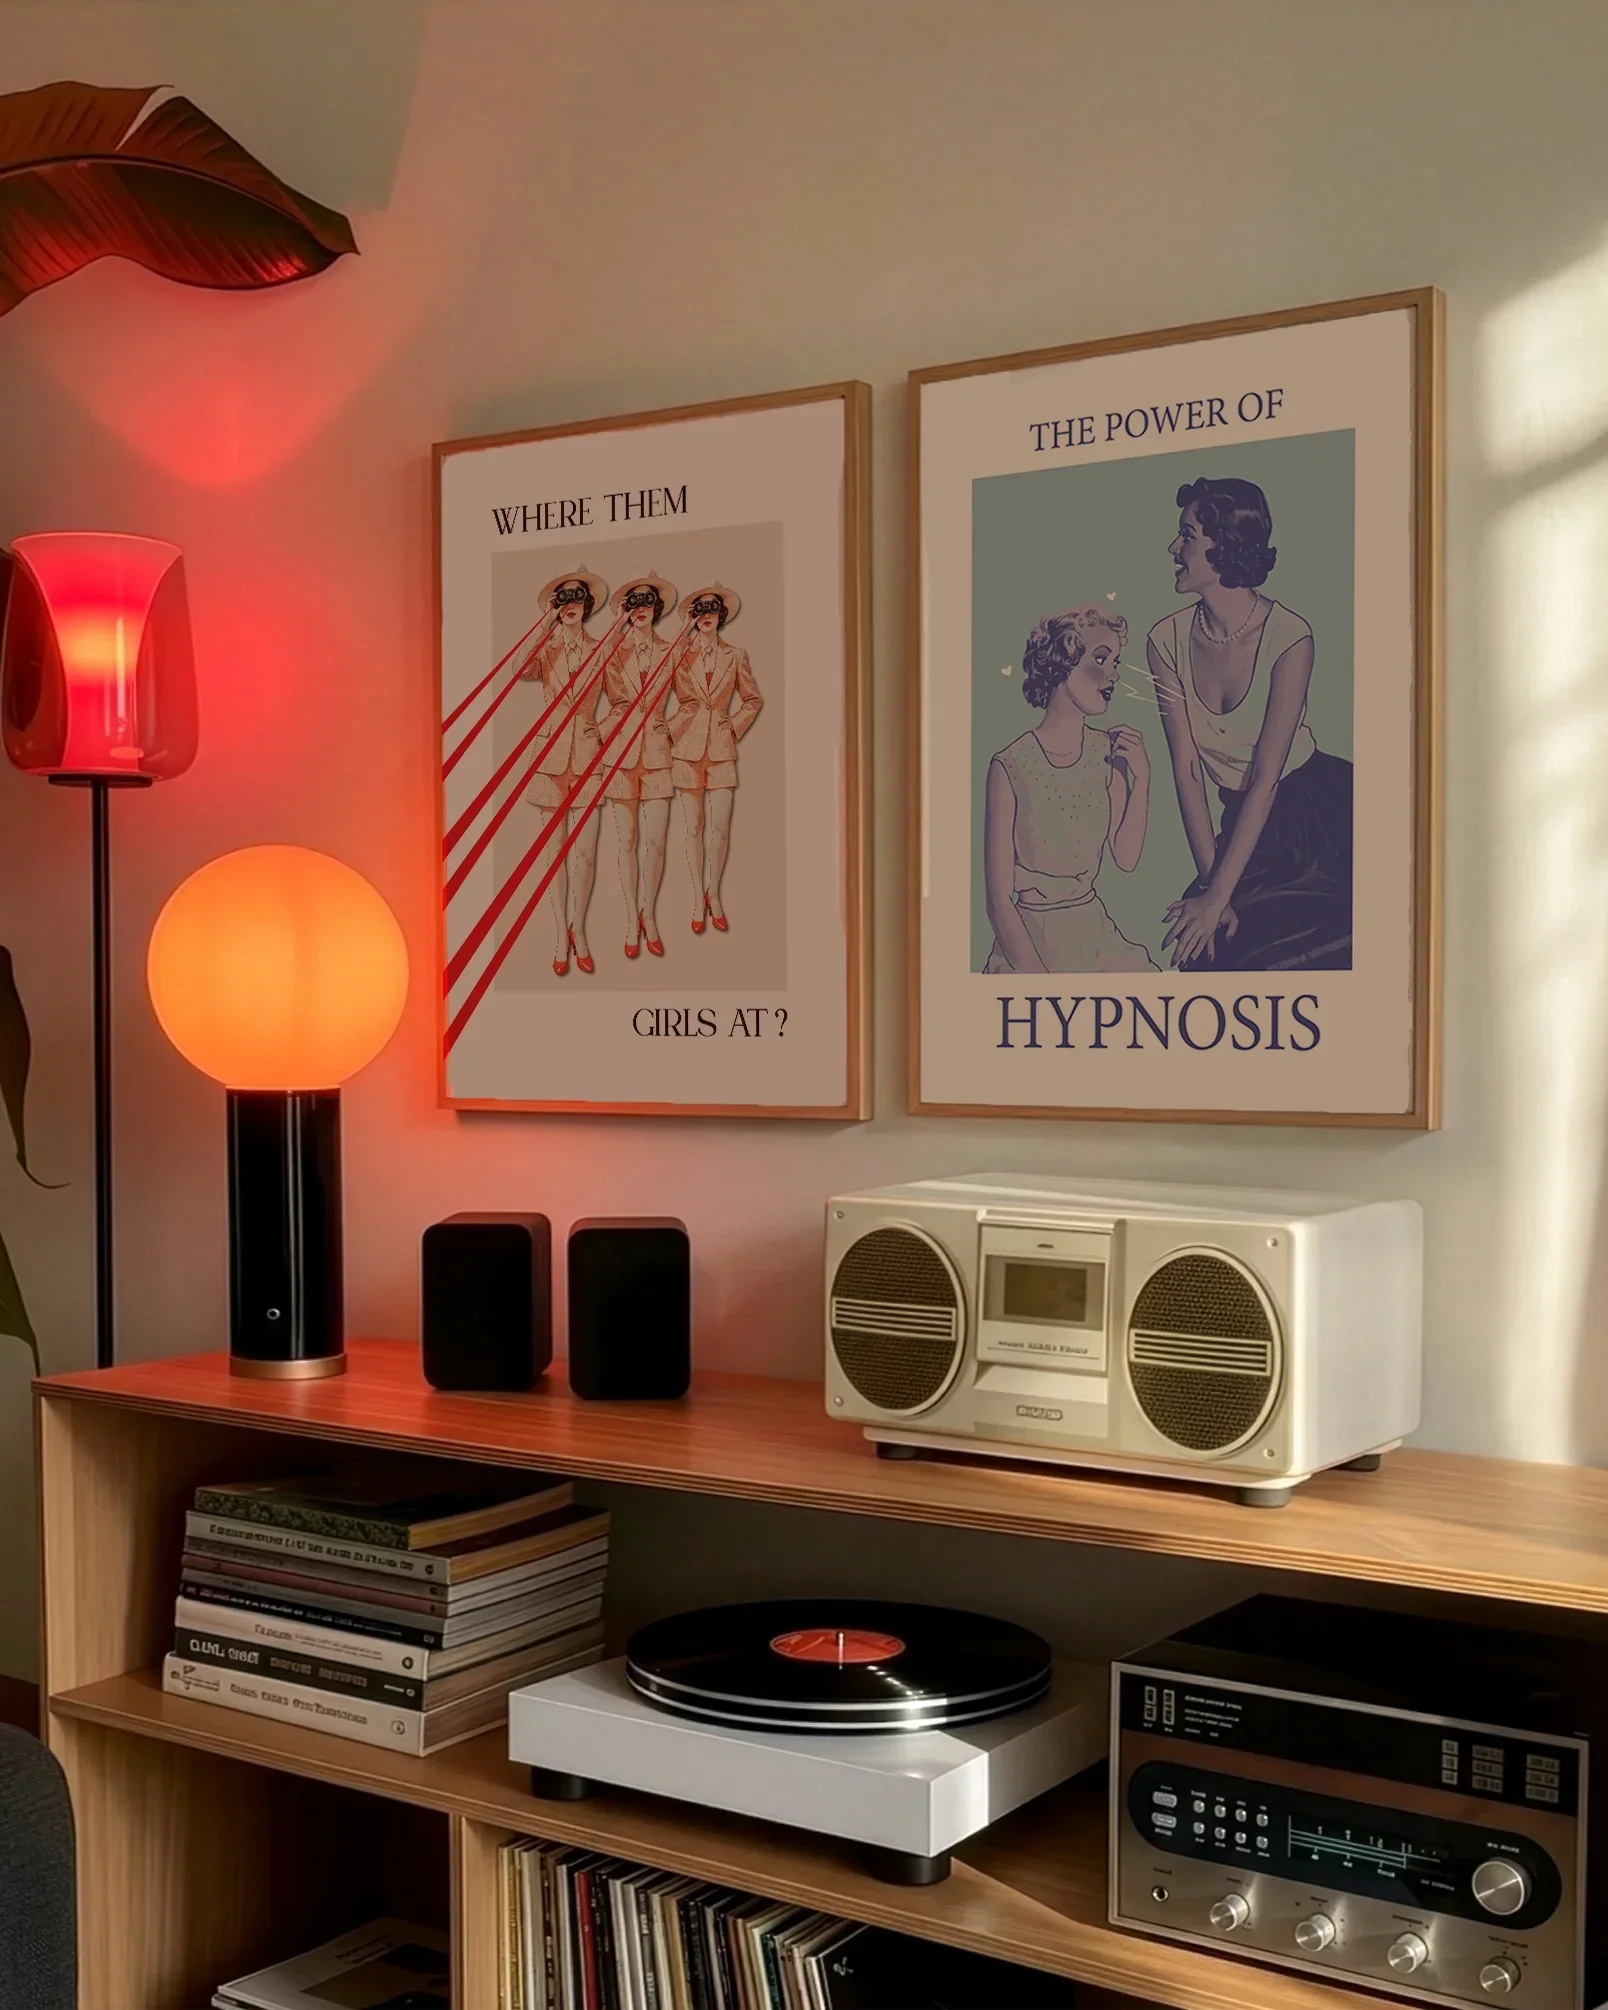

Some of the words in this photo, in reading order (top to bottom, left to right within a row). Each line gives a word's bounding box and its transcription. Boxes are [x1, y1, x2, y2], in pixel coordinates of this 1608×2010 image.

[1028, 415, 1096, 452] THE
[1104, 397, 1229, 442] POWER
[1237, 388, 1284, 423] OF
[492, 496, 594, 536] WHERE
[603, 484, 688, 523] THEM
[632, 1008, 717, 1038] GIRLS
[996, 994, 1321, 1052] HYPNOSIS
